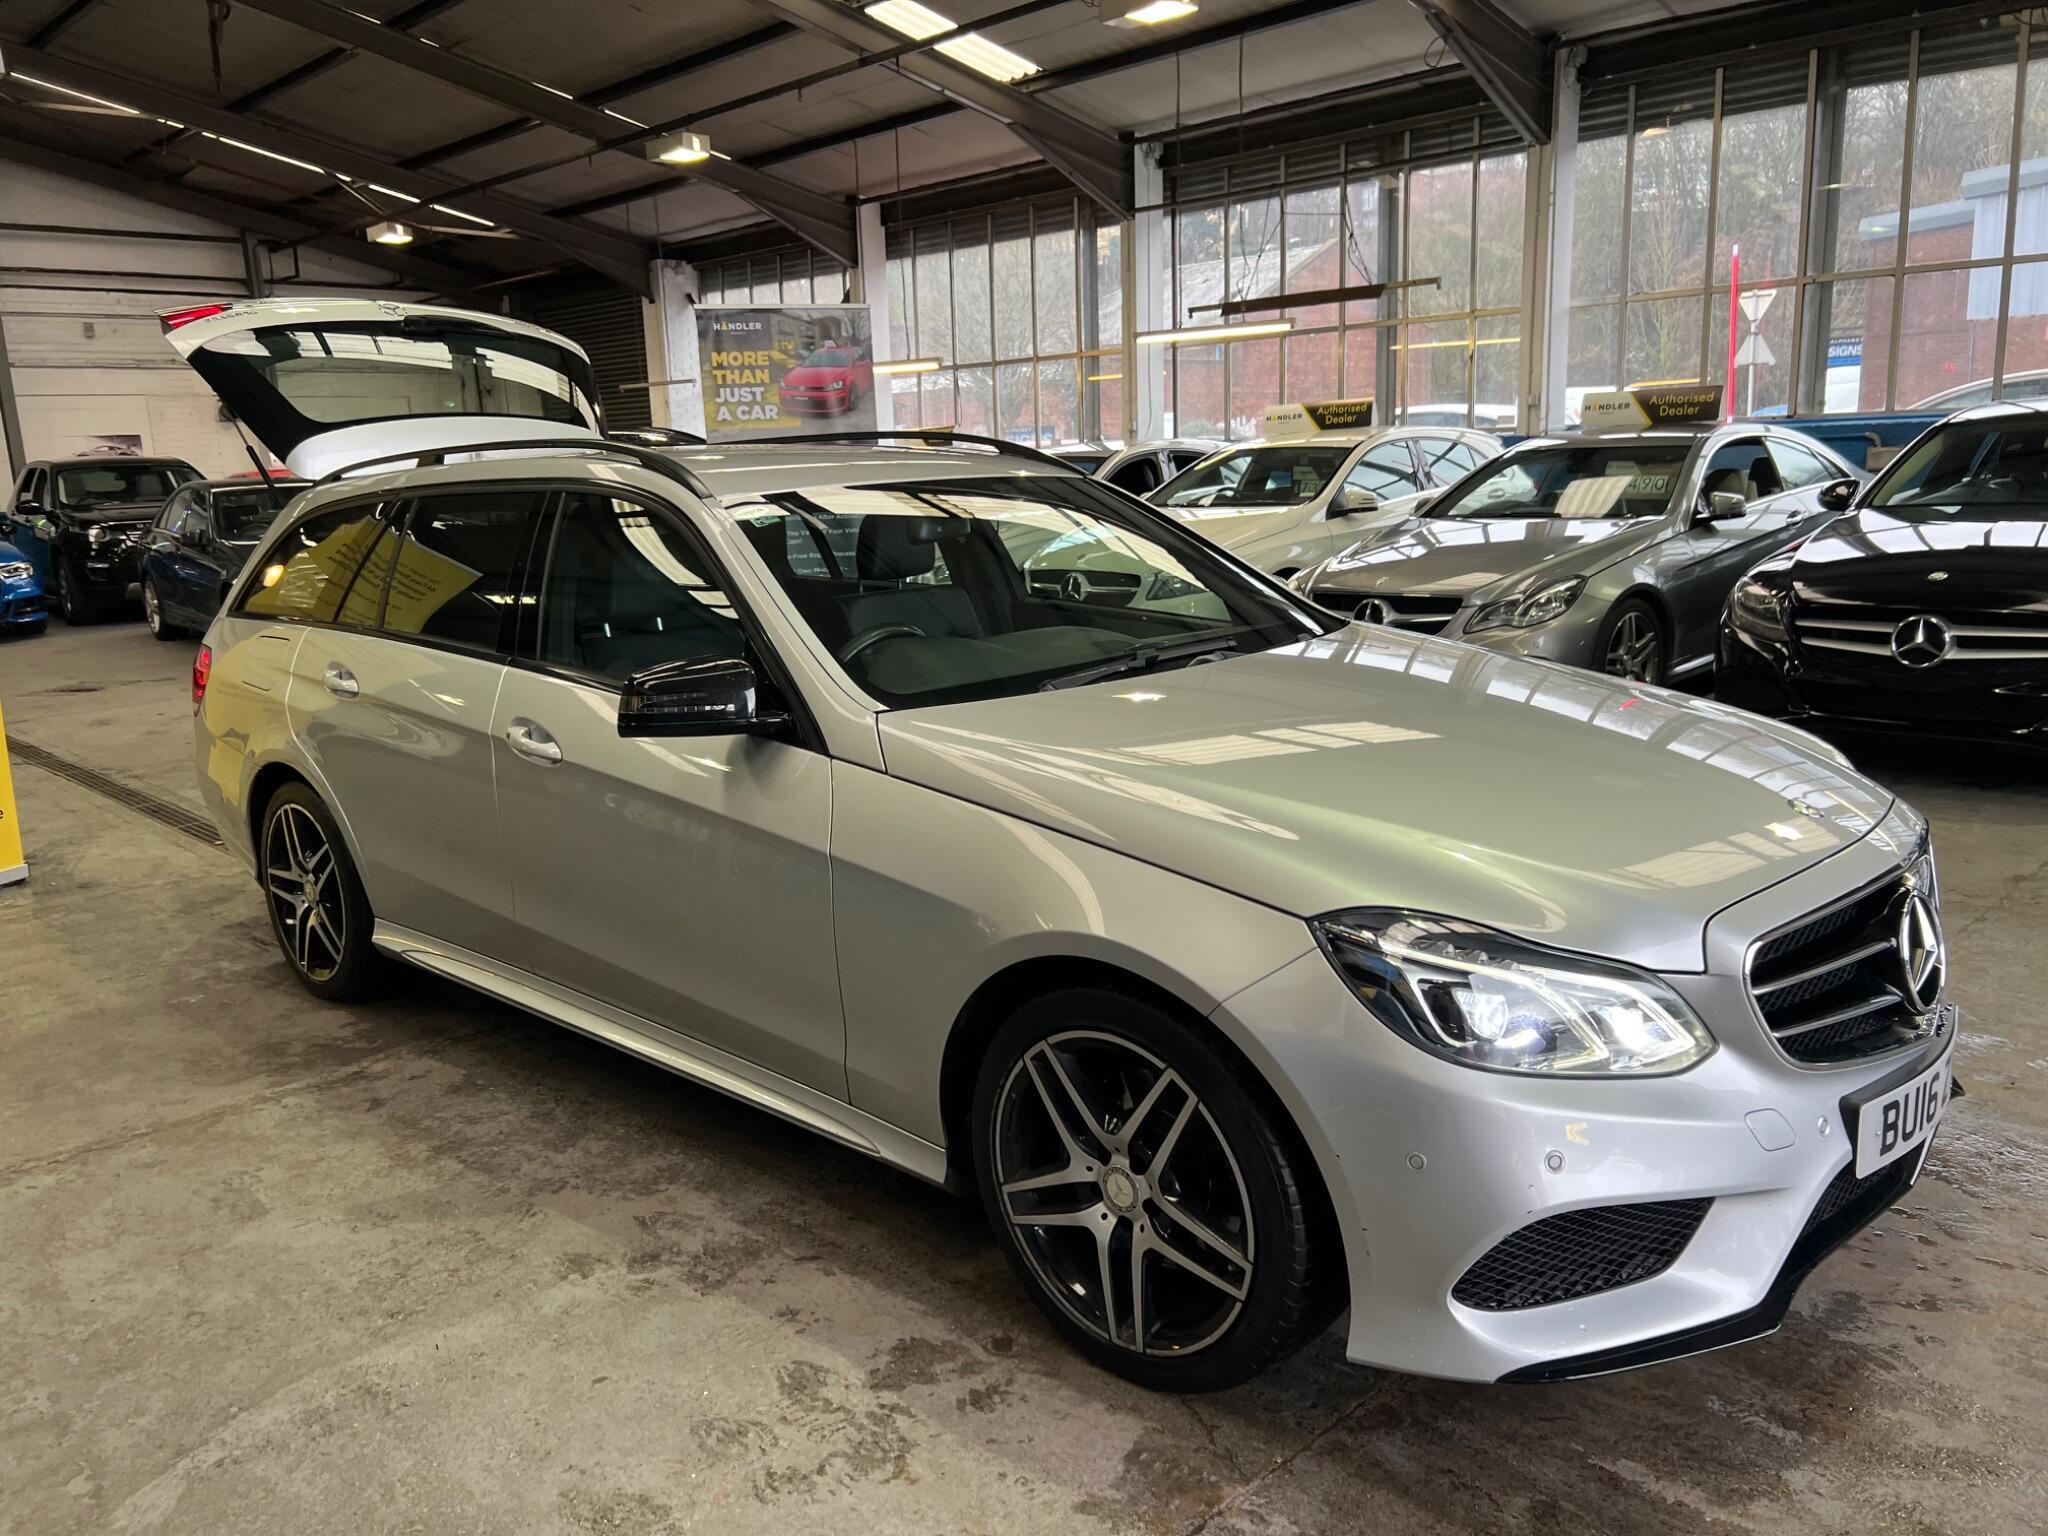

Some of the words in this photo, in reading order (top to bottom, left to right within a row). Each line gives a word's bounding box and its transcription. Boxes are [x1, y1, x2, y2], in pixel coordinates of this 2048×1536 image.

[1828, 344, 1863, 358] SIGNS
[711, 351, 770, 367] MORE
[712, 369, 770, 385] THAN
[715, 387, 765, 403] JUST
[1649, 391, 1715, 405] Authorised
[717, 406, 732, 421] A
[736, 405, 779, 420] CAR
[1316, 402, 1368, 415] Authorised
[1660, 404, 1700, 417] Dealer
[1325, 413, 1357, 424] Dealer
[1880, 1071, 1940, 1157] BU16
